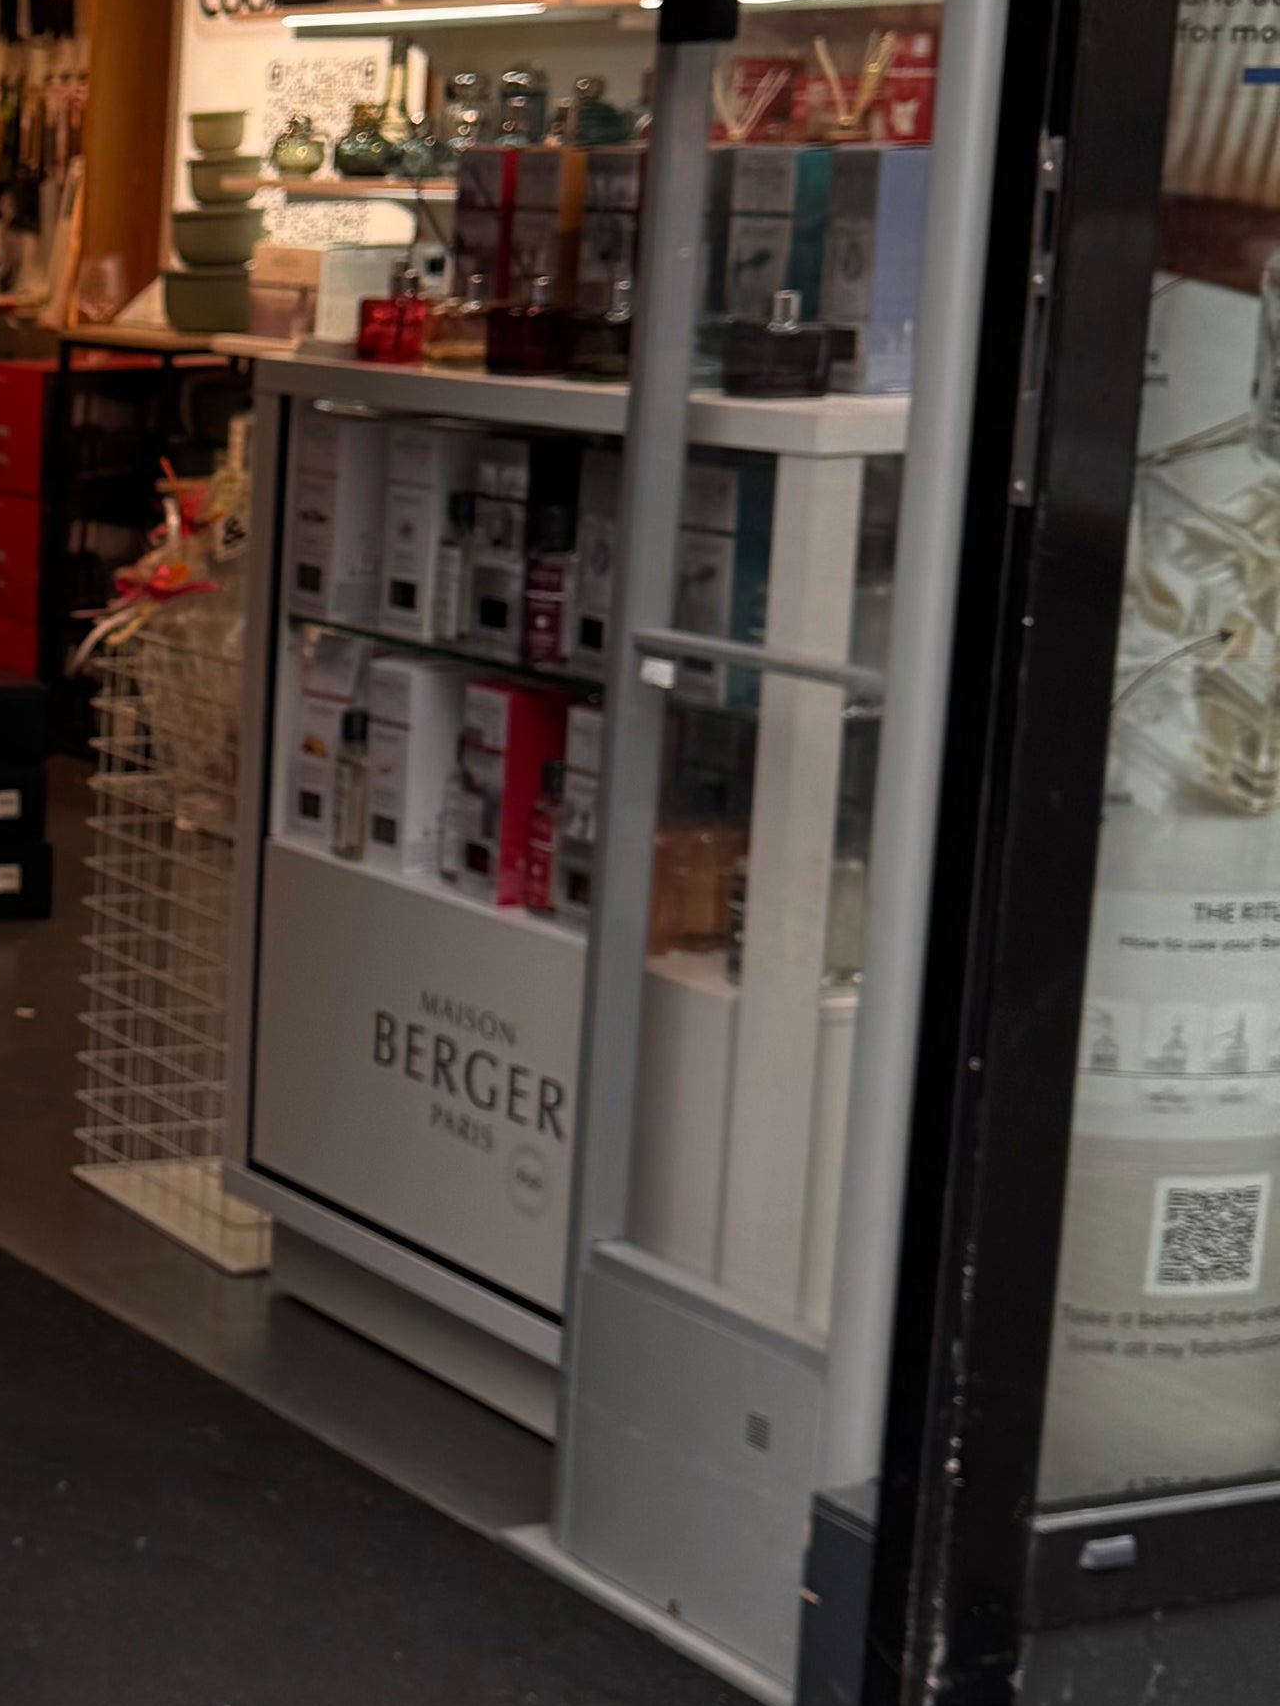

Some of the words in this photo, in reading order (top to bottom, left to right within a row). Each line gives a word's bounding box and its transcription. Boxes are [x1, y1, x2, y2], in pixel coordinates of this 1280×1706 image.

[1193, 901, 1237, 924] THE
[419, 990, 517, 1046] MAISON
[374, 1009, 566, 1143] BERGER
[429, 1101, 495, 1155] PARIS
